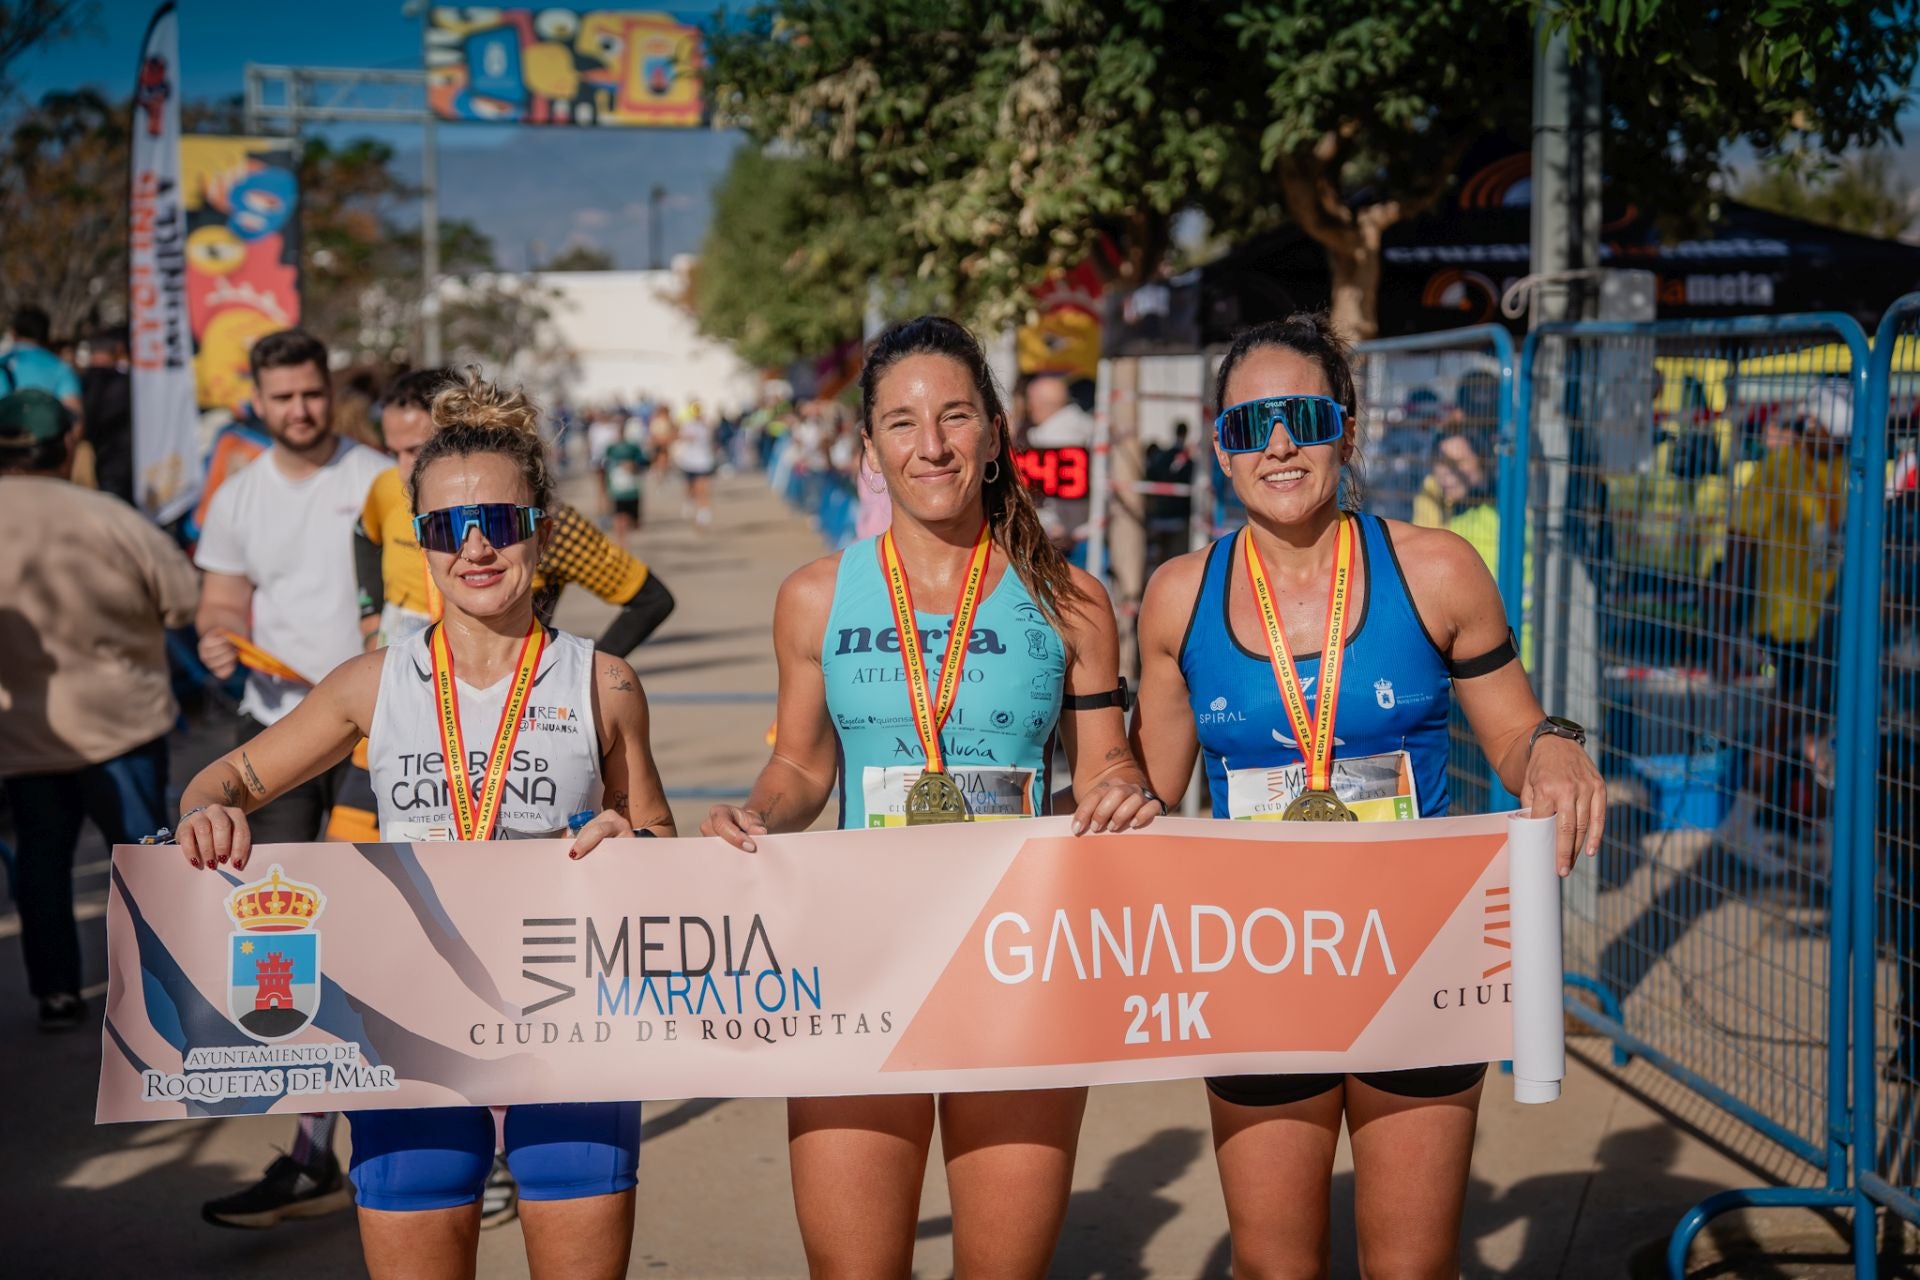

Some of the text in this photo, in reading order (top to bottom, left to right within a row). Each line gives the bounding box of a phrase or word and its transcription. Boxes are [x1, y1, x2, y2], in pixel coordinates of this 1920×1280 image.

[892, 567, 900, 582] MAR
[896, 585, 903, 594] DE
[1336, 588, 1344, 598] DE
[898, 596, 910, 634] ROQUETAS
[950, 640, 960, 669] CIUDAD
[956, 597, 972, 637] ROQUETAS
[967, 586, 975, 596] DE
[972, 567, 980, 584] MAR
[1330, 602, 1342, 646] ROQUETAS
[906, 637, 918, 667] CIUDAD
[1256, 577, 1267, 600] MEDIA
[1275, 645, 1290, 678] CIUDAD
[1286, 680, 1304, 726] ROQUETAS
[1300, 728, 1309, 740] DE
[1326, 650, 1336, 684] CIUDAD
[493, 744, 506, 776] CIUDAD
[502, 699, 520, 740] ROQUETAS
[516, 686, 524, 696] DE
[520, 668, 530, 685] MAR
[1200, 711, 1246, 724] SPIRAL
[1322, 686, 1332, 730] MARATÓN
[922, 714, 930, 742] MEDIA
[440, 671, 448, 695] MEDIA
[449, 740, 460, 772] CIUDAD
[456, 774, 469, 820] ROQUETAS
[464, 824, 472, 834] DE
[894, 736, 997, 762] Analucía
[1316, 734, 1326, 760] MEDIA
[586, 914, 782, 978] MEDIA
[984, 903, 1397, 985] GANADORA
[597, 966, 821, 1016] MARATON
[470, 1010, 892, 1046] CIUDAD DE ROQUETAS
[1124, 991, 1211, 1044] 21K
[190, 1046, 356, 1066] AYUNTAMIENTO DE
[292, 1072, 322, 1090] DE
